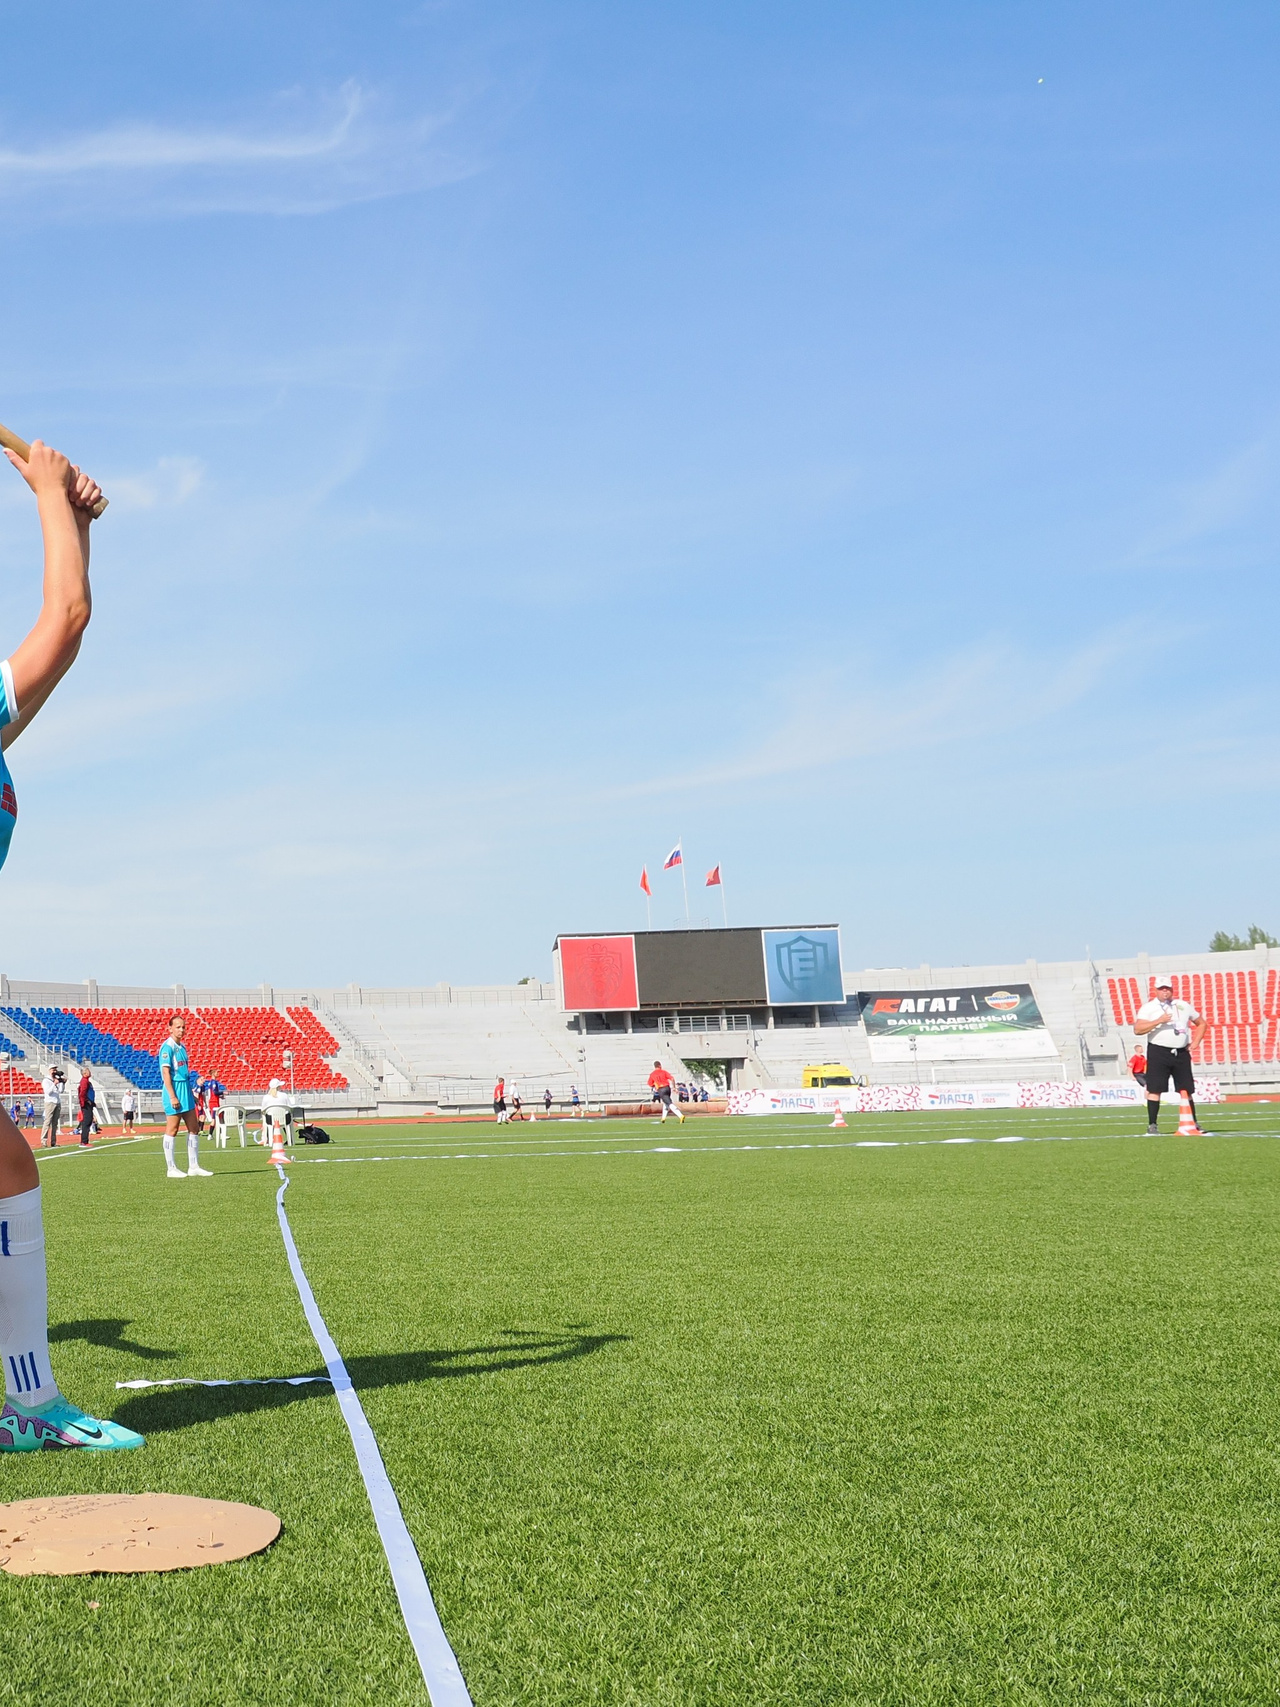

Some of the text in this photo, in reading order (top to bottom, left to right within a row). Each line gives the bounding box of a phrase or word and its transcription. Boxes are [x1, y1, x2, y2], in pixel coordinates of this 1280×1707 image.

[899, 997, 961, 1014] АГАТ
[887, 1013, 1018, 1026] ВАШ НАДЕЖНЫЙ
[919, 1022, 989, 1032] ПАРТНЕР
[938, 1093, 975, 1104] ЛАПТА
[1100, 1088, 1138, 1100] ЛАПТА
[780, 1098, 816, 1109] ЛАПТА
